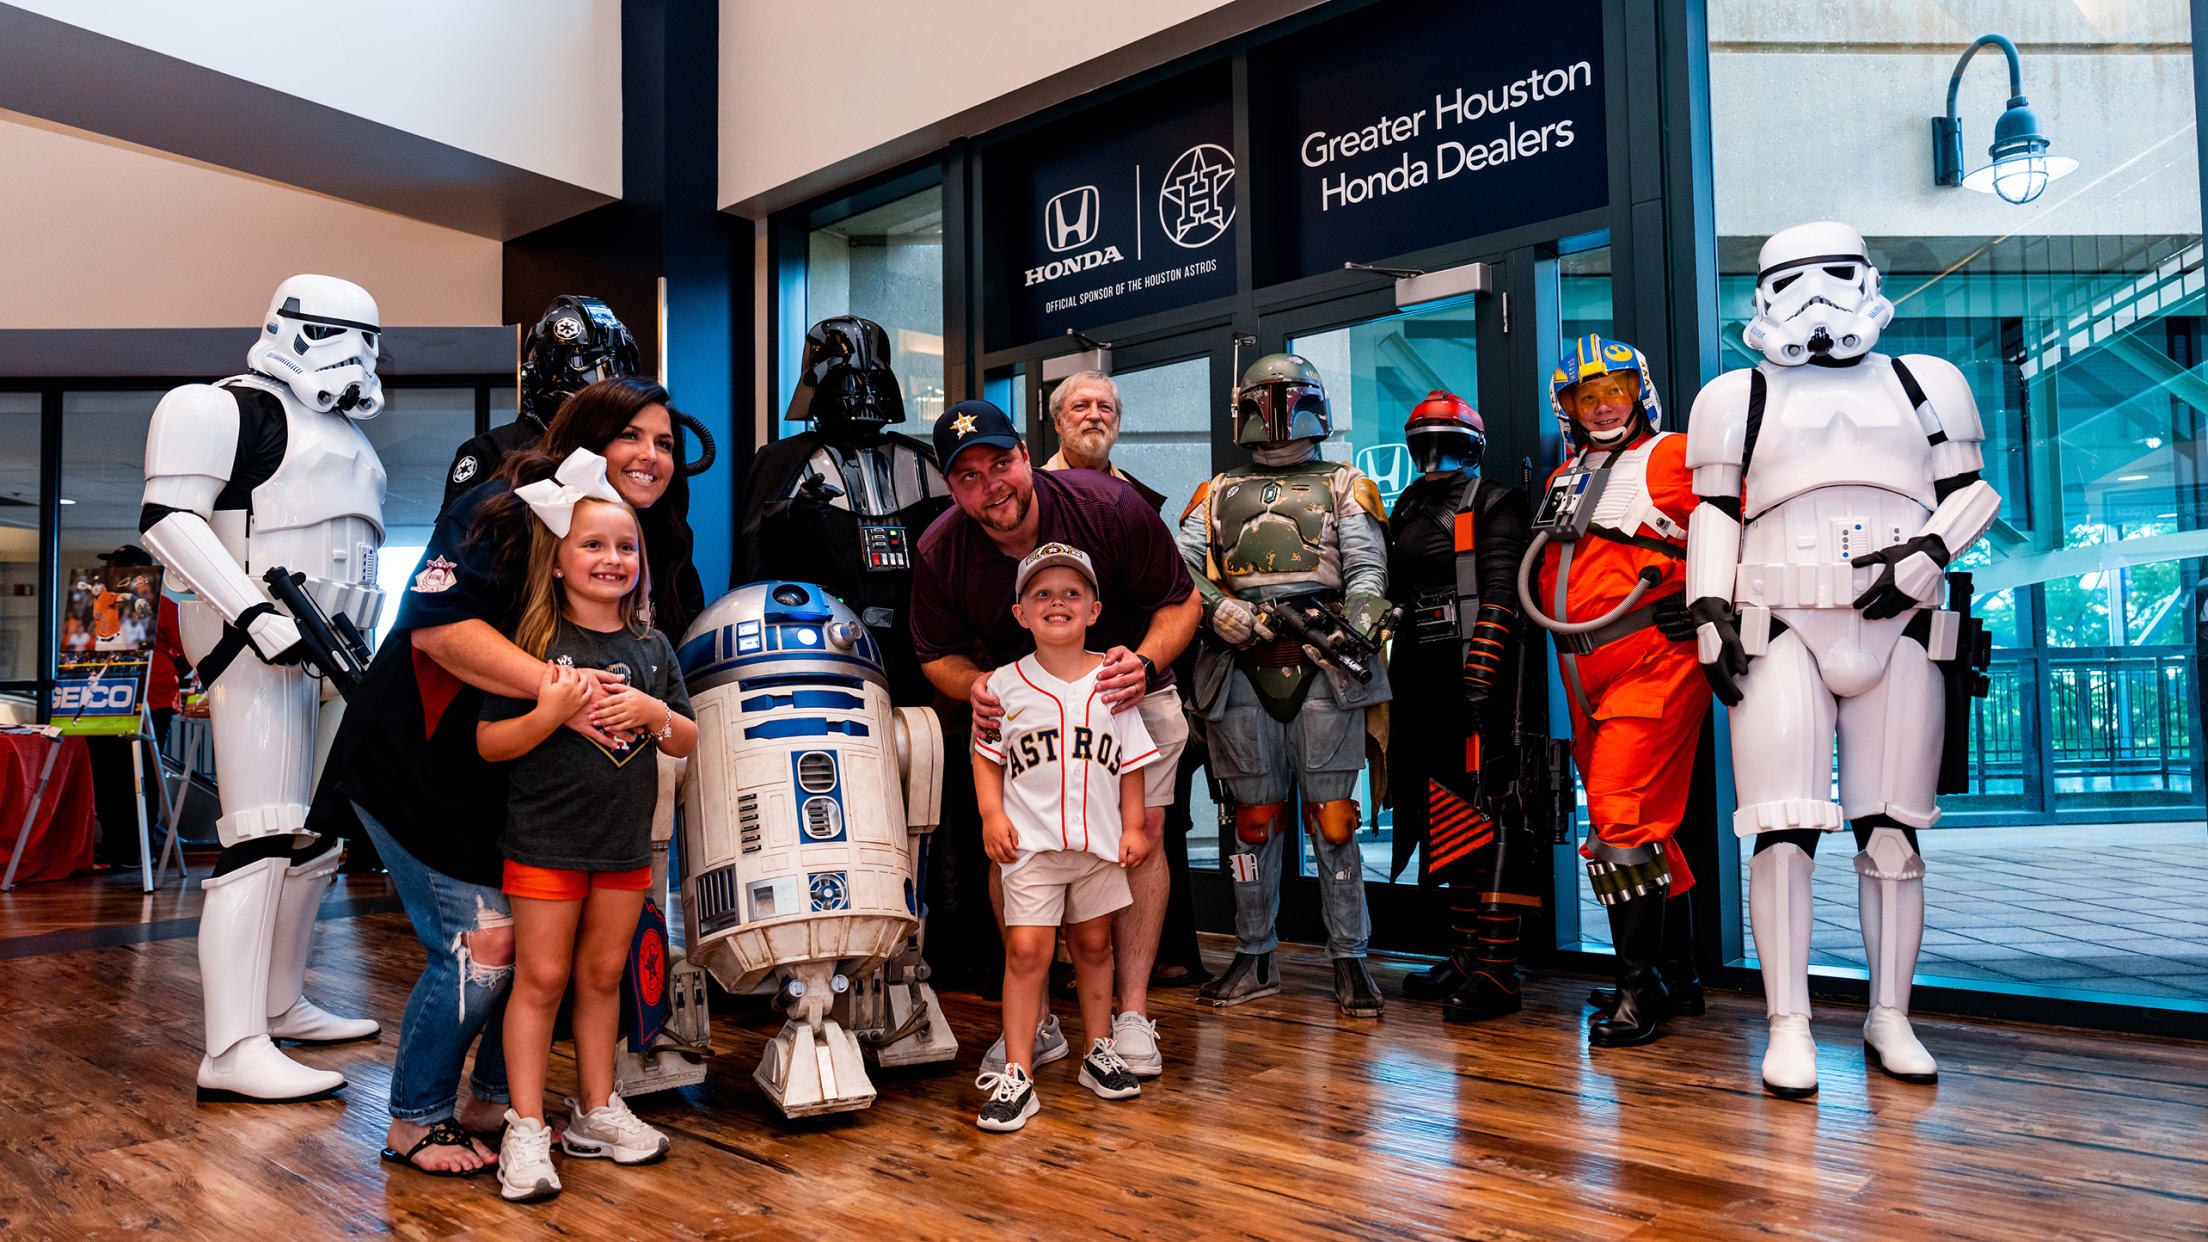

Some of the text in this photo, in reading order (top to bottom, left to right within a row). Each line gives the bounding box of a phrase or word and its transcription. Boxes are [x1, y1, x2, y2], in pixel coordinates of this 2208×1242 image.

[1301, 60, 1592, 168] Greater Houston
[1321, 119, 1576, 211] Honda Dealers
[1024, 245, 1125, 287] HONDA
[1045, 258, 1218, 314] OFFICIAL SPONSOR OF THE HOUSTON ASTROS
[1009, 725, 1122, 780] ASTROS
